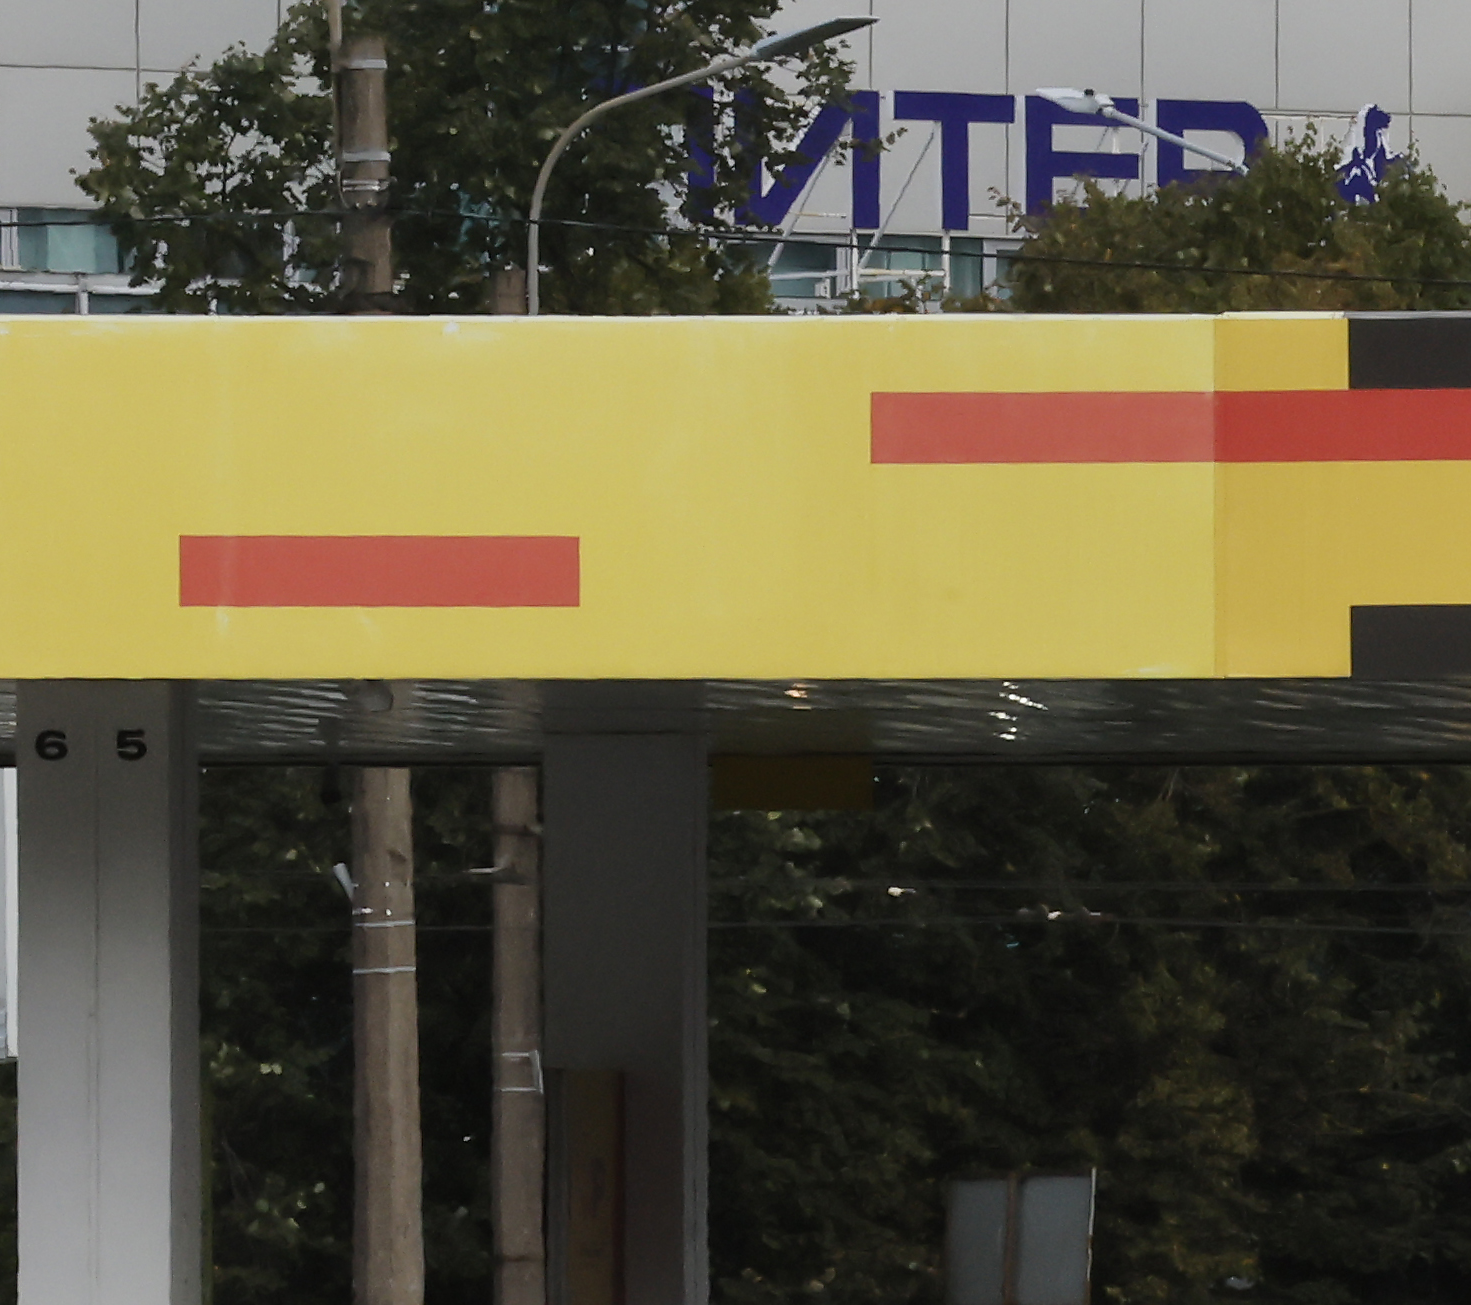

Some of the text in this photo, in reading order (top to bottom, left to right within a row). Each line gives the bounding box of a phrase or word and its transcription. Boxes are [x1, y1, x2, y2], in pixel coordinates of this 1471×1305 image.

[598, 82, 1268, 232] ИТЕР
[35, 729, 148, 761] 6 5
